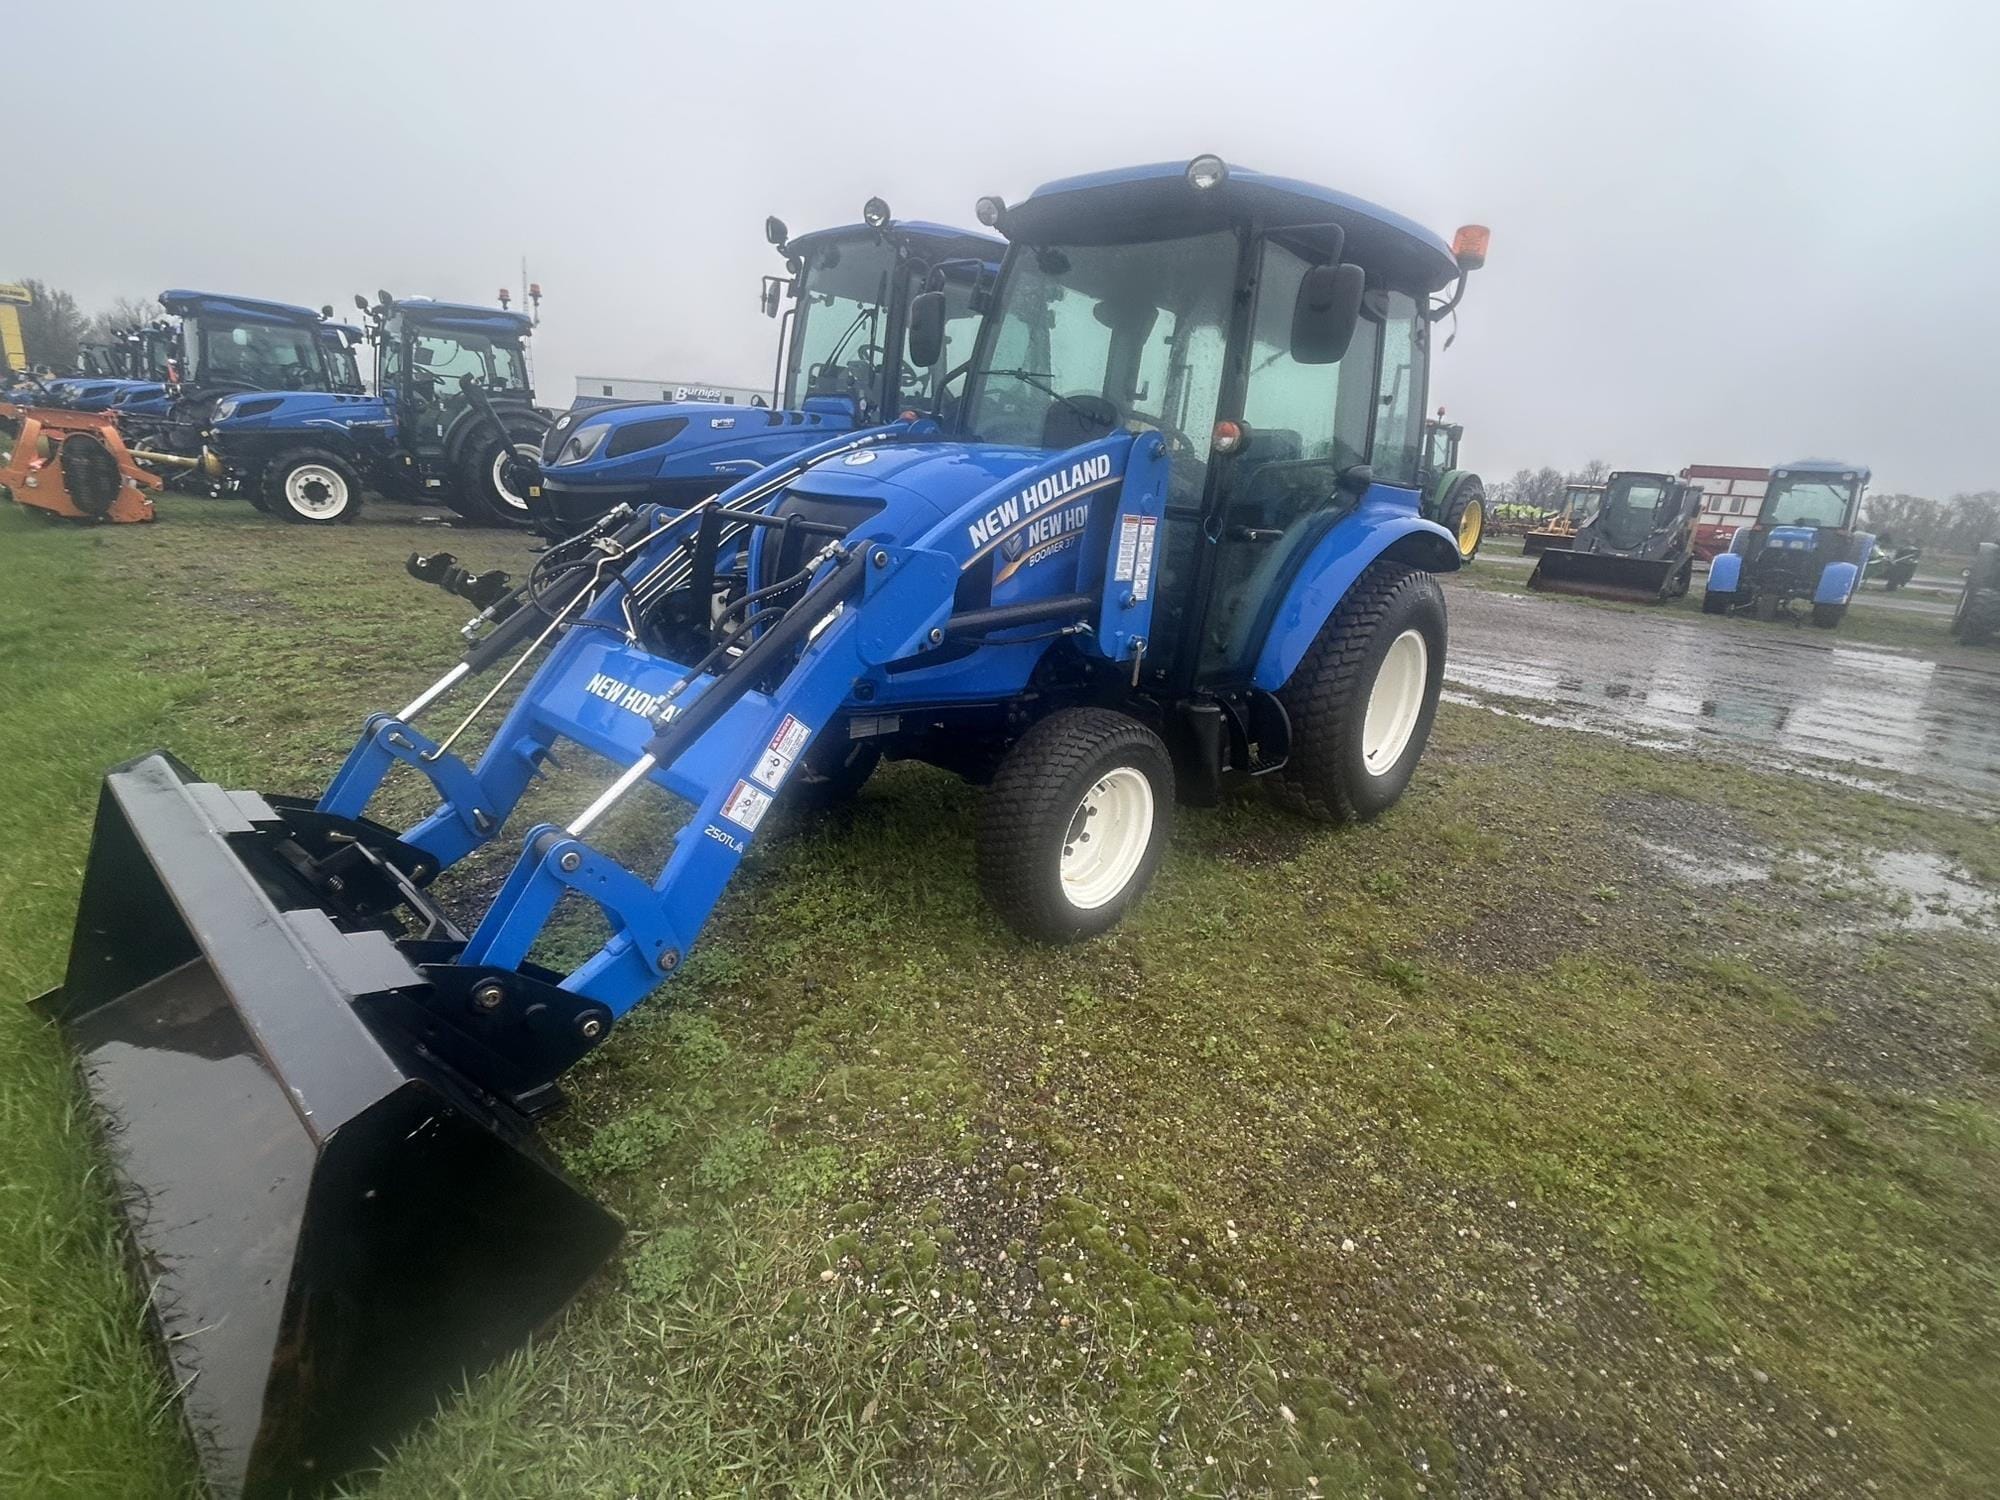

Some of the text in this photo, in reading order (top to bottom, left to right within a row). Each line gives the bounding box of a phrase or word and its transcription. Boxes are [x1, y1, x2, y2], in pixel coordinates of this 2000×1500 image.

[675, 386, 720, 401] Burnips
[968, 454, 1111, 549] NEW HOLLAND
[1028, 511, 1063, 548] NEW
[585, 672, 628, 703] NEW
[704, 824, 744, 853] 250TLA
